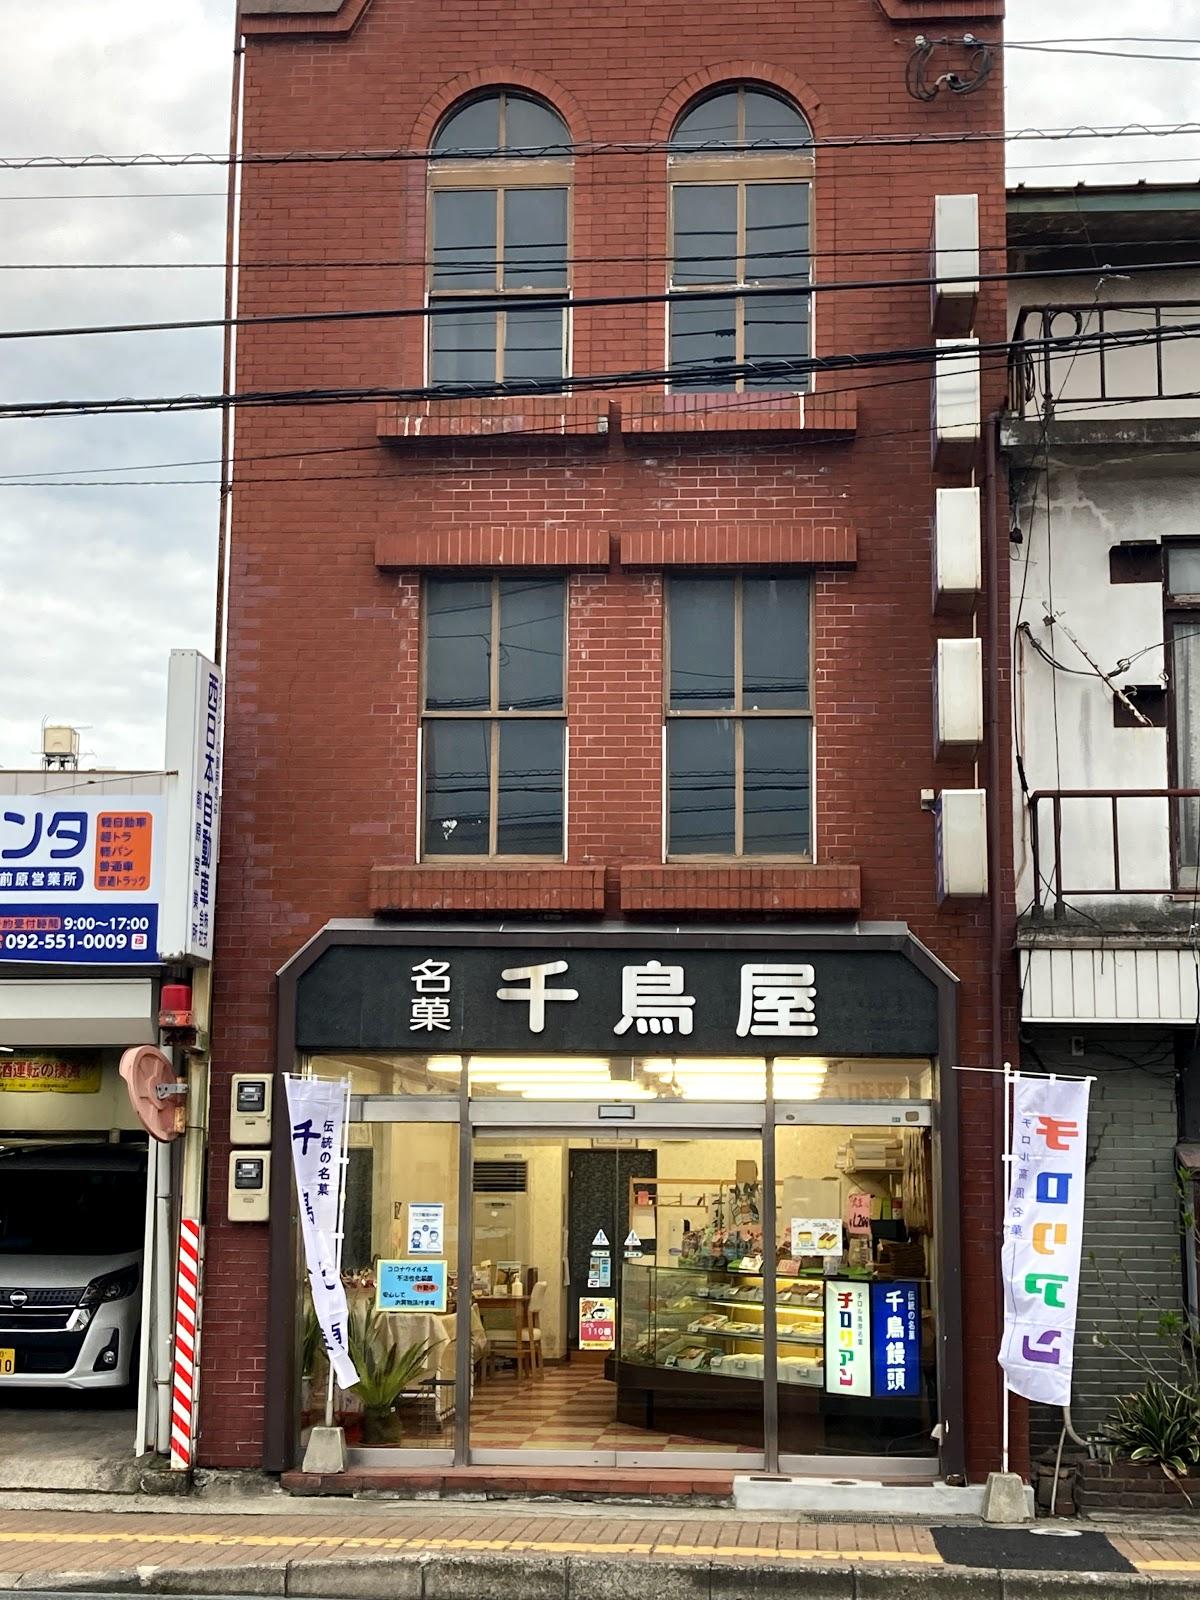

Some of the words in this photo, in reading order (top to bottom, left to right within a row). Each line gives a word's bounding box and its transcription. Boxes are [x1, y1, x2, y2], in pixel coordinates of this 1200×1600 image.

[2, 812, 88, 859] ンタ
[0, 871, 77, 887] 前原営業所
[5, 933, 127, 949] 092-551-0009
[409, 958, 451, 1031] 名菓
[497, 960, 819, 1037] 千鳥屋
[317, 1120, 334, 1196] 伝統の名菓
[837, 1291, 854, 1387] チロリアン
[885, 1290, 905, 1391] 千鳥饅頭
